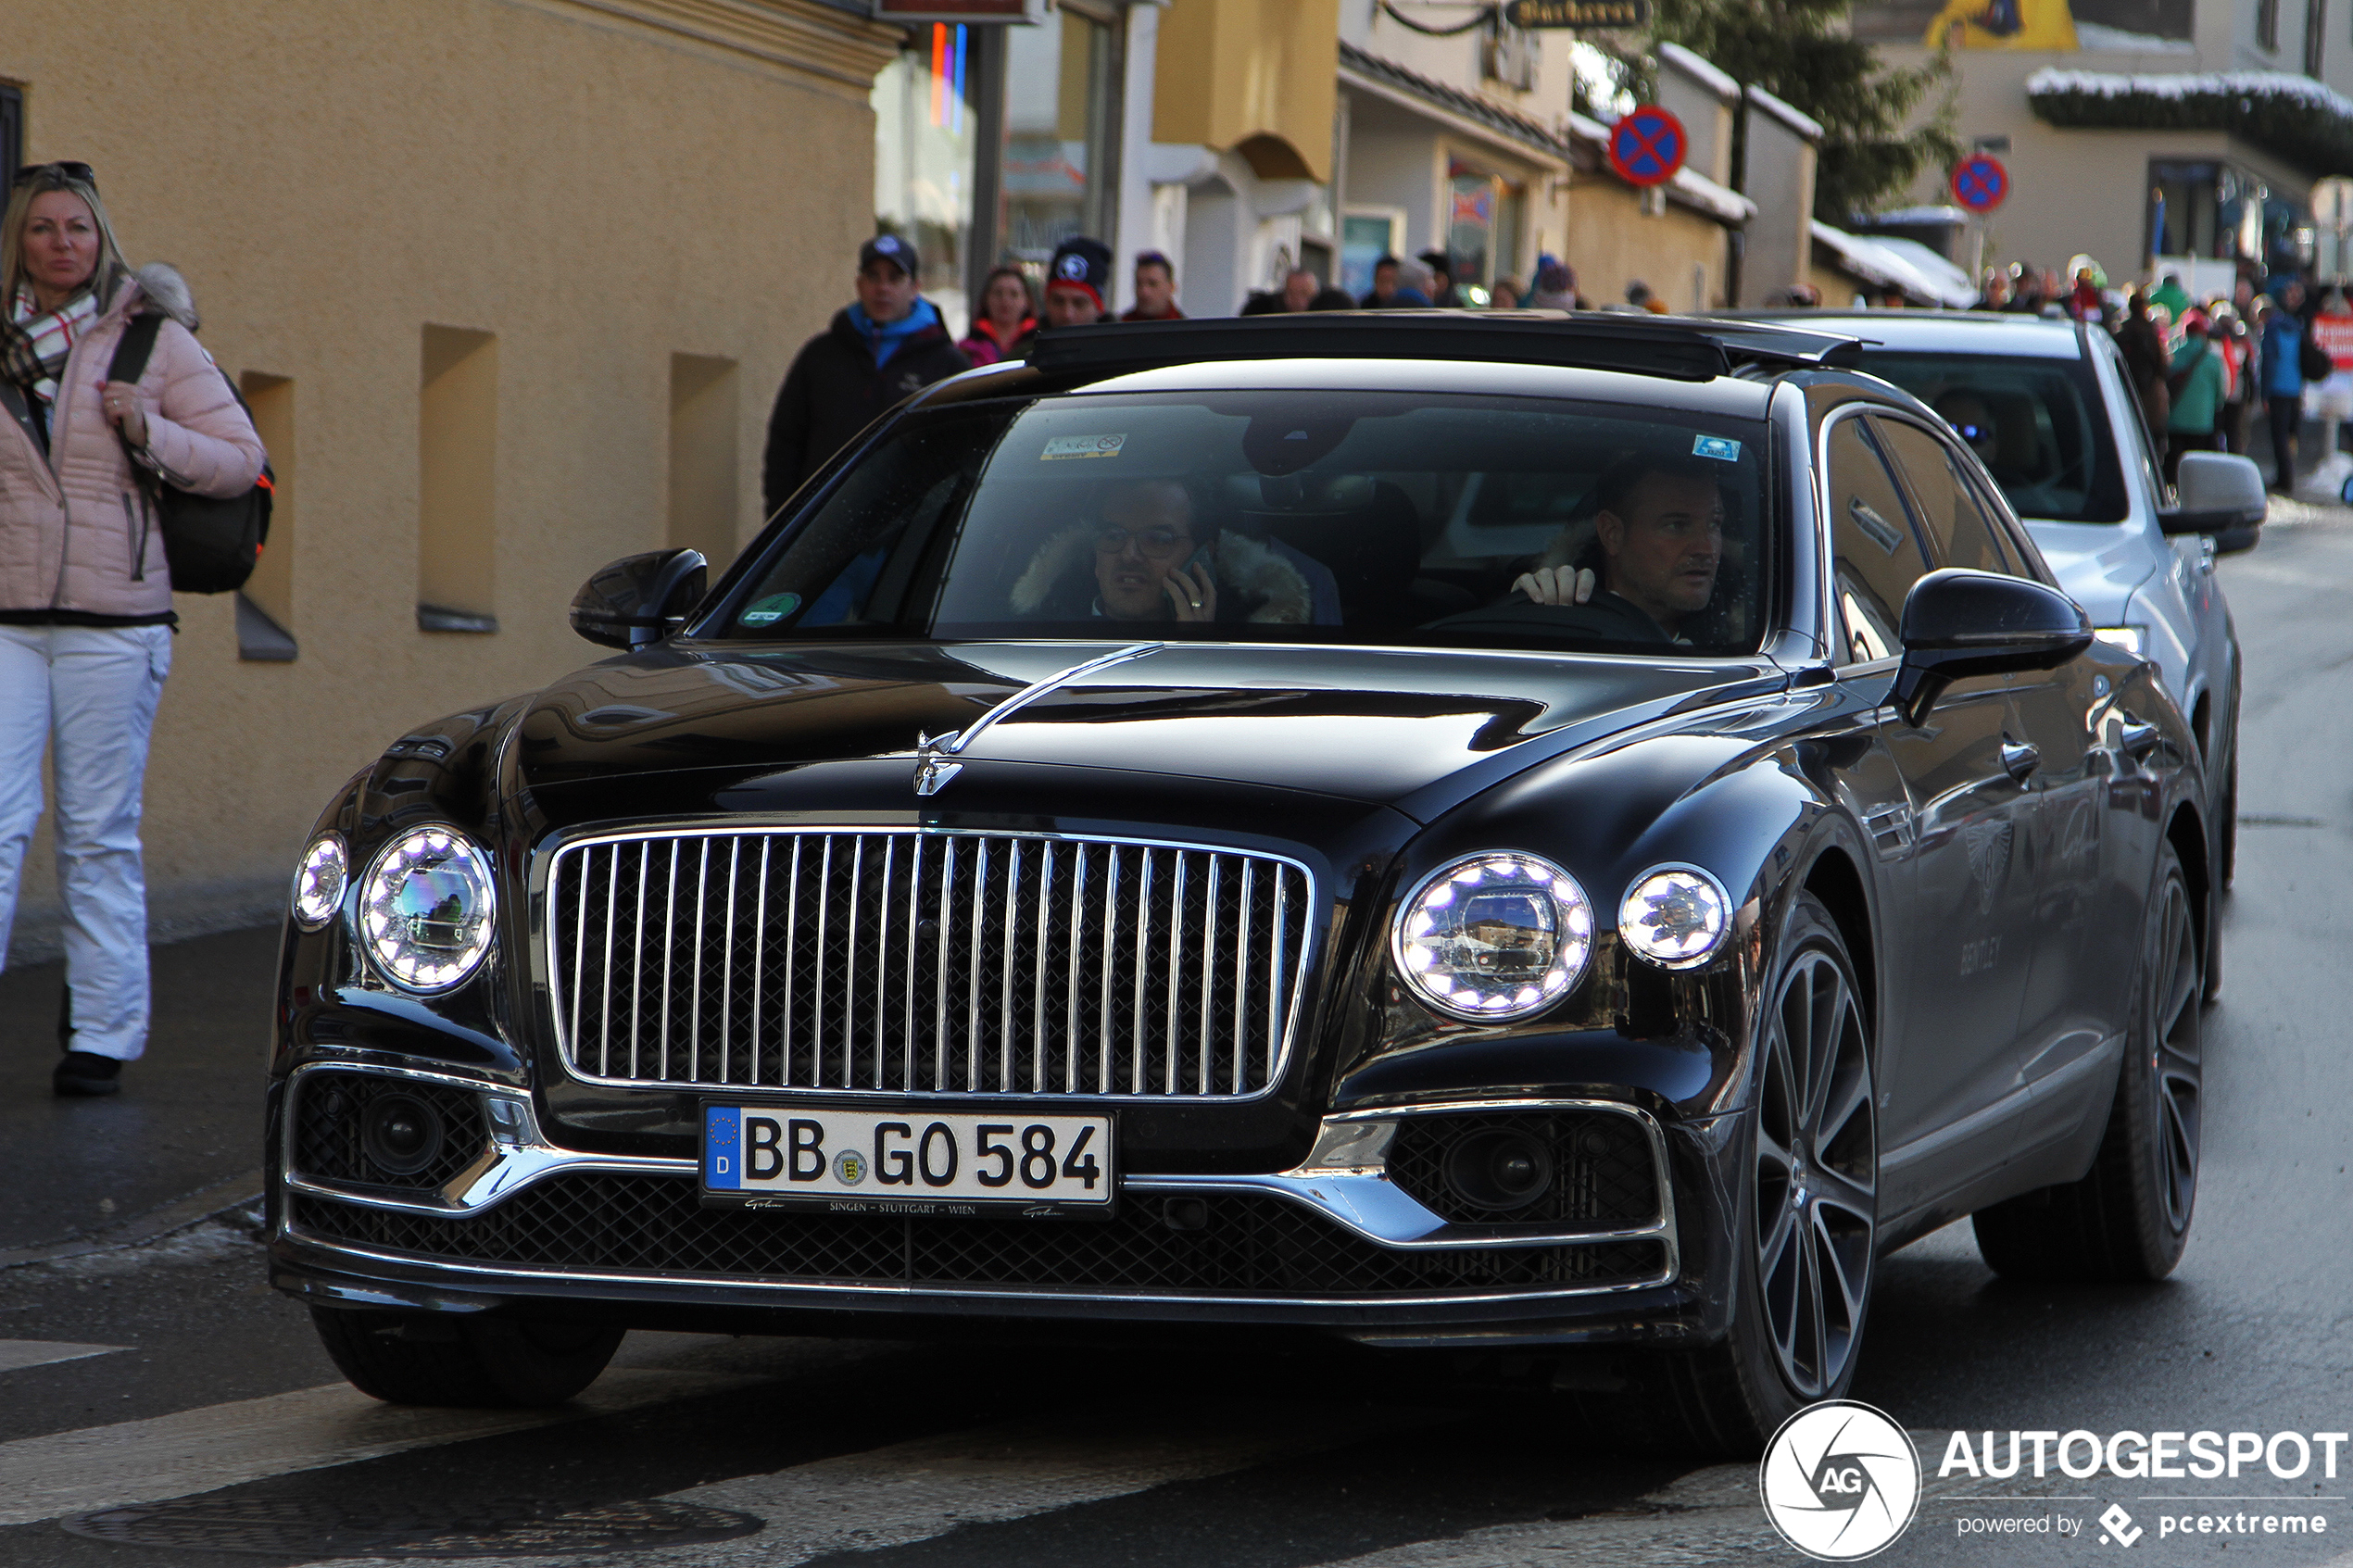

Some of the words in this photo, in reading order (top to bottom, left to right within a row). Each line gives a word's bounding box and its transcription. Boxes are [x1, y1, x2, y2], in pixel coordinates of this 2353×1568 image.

[1960, 935, 2003, 975] BENTLEY
[716, 1156, 729, 1174] D
[745, 1116, 827, 1182] BB
[874, 1122, 959, 1187] GO
[976, 1123, 1101, 1190] 584
[830, 1202, 866, 1211] SINGEN
[879, 1203, 936, 1213] STUTTGART
[948, 1205, 975, 1215] WIEN
